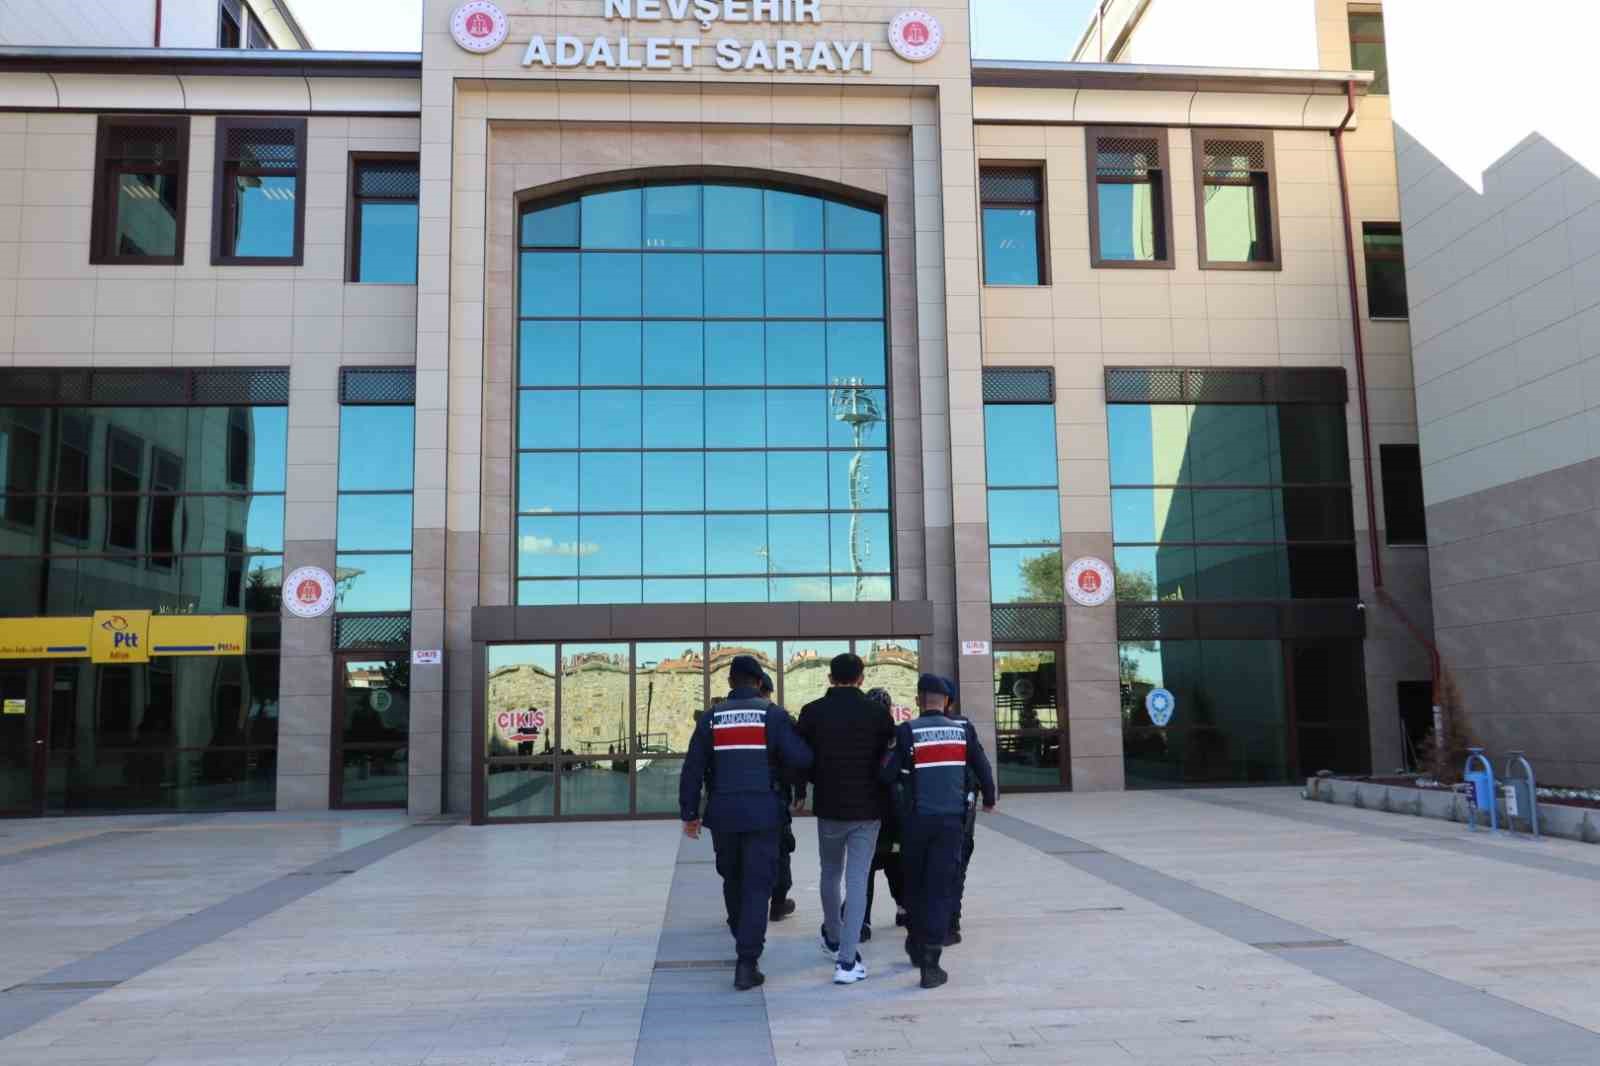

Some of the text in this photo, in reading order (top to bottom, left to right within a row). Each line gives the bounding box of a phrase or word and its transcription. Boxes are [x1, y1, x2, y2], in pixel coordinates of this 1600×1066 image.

[523, 35, 872, 72] ADALET SARAYI
[114, 632, 138, 648] Ptt
